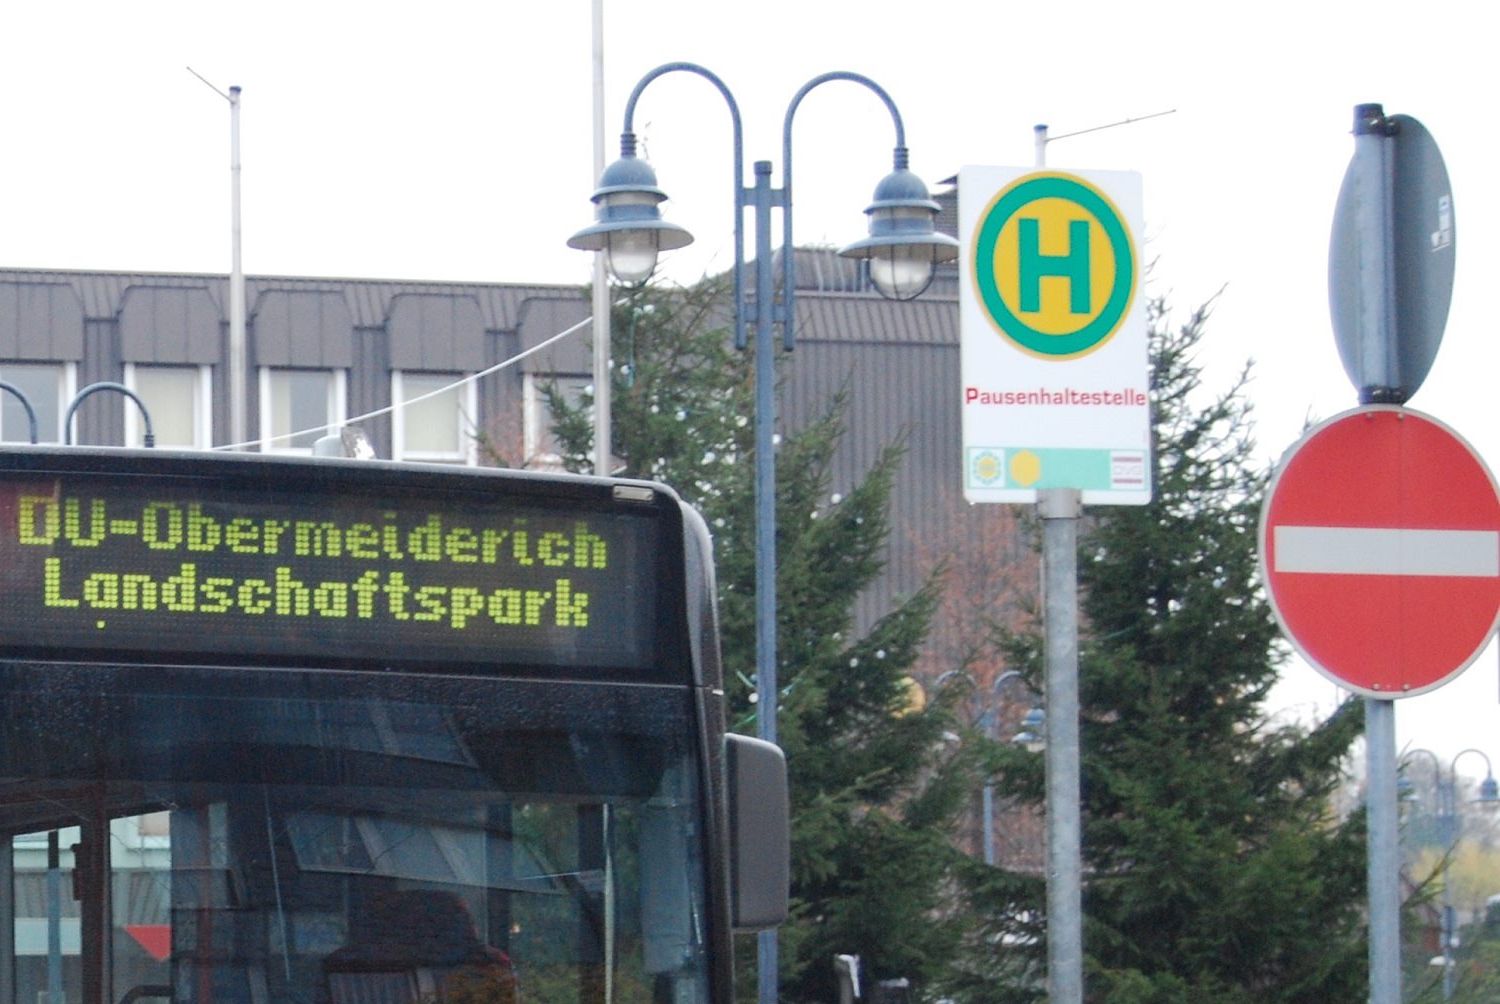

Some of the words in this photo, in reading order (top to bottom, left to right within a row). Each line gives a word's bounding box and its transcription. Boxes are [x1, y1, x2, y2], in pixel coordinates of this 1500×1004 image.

[1019, 218, 1090, 314] H
[965, 387, 1146, 406] Pausenhaltestelle
[18, 496, 607, 568] DU-Obermeiderich
[45, 557, 589, 629] Landschaftspark
